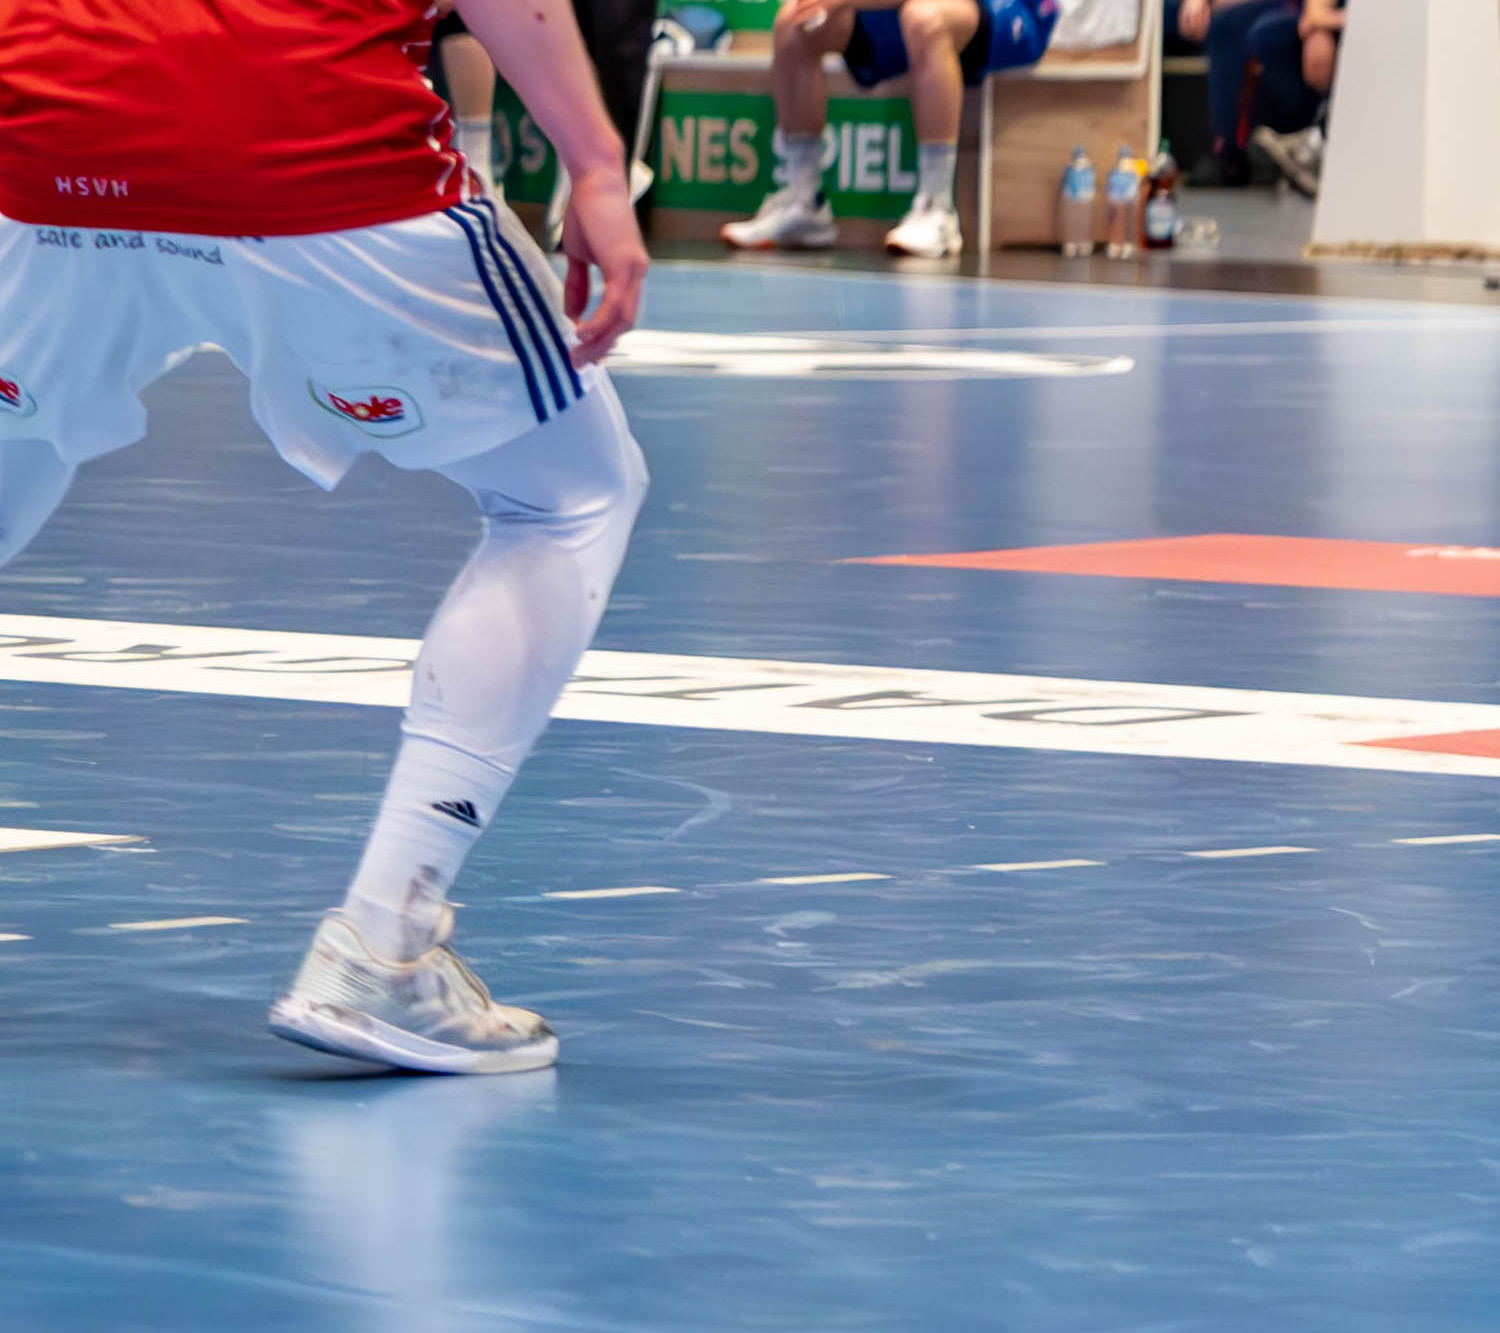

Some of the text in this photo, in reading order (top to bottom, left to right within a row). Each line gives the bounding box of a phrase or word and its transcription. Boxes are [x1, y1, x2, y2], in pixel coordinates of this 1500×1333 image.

[55, 176, 129, 198] HSVH
[94, 231, 146, 250] and
[156, 237, 225, 267] sound
